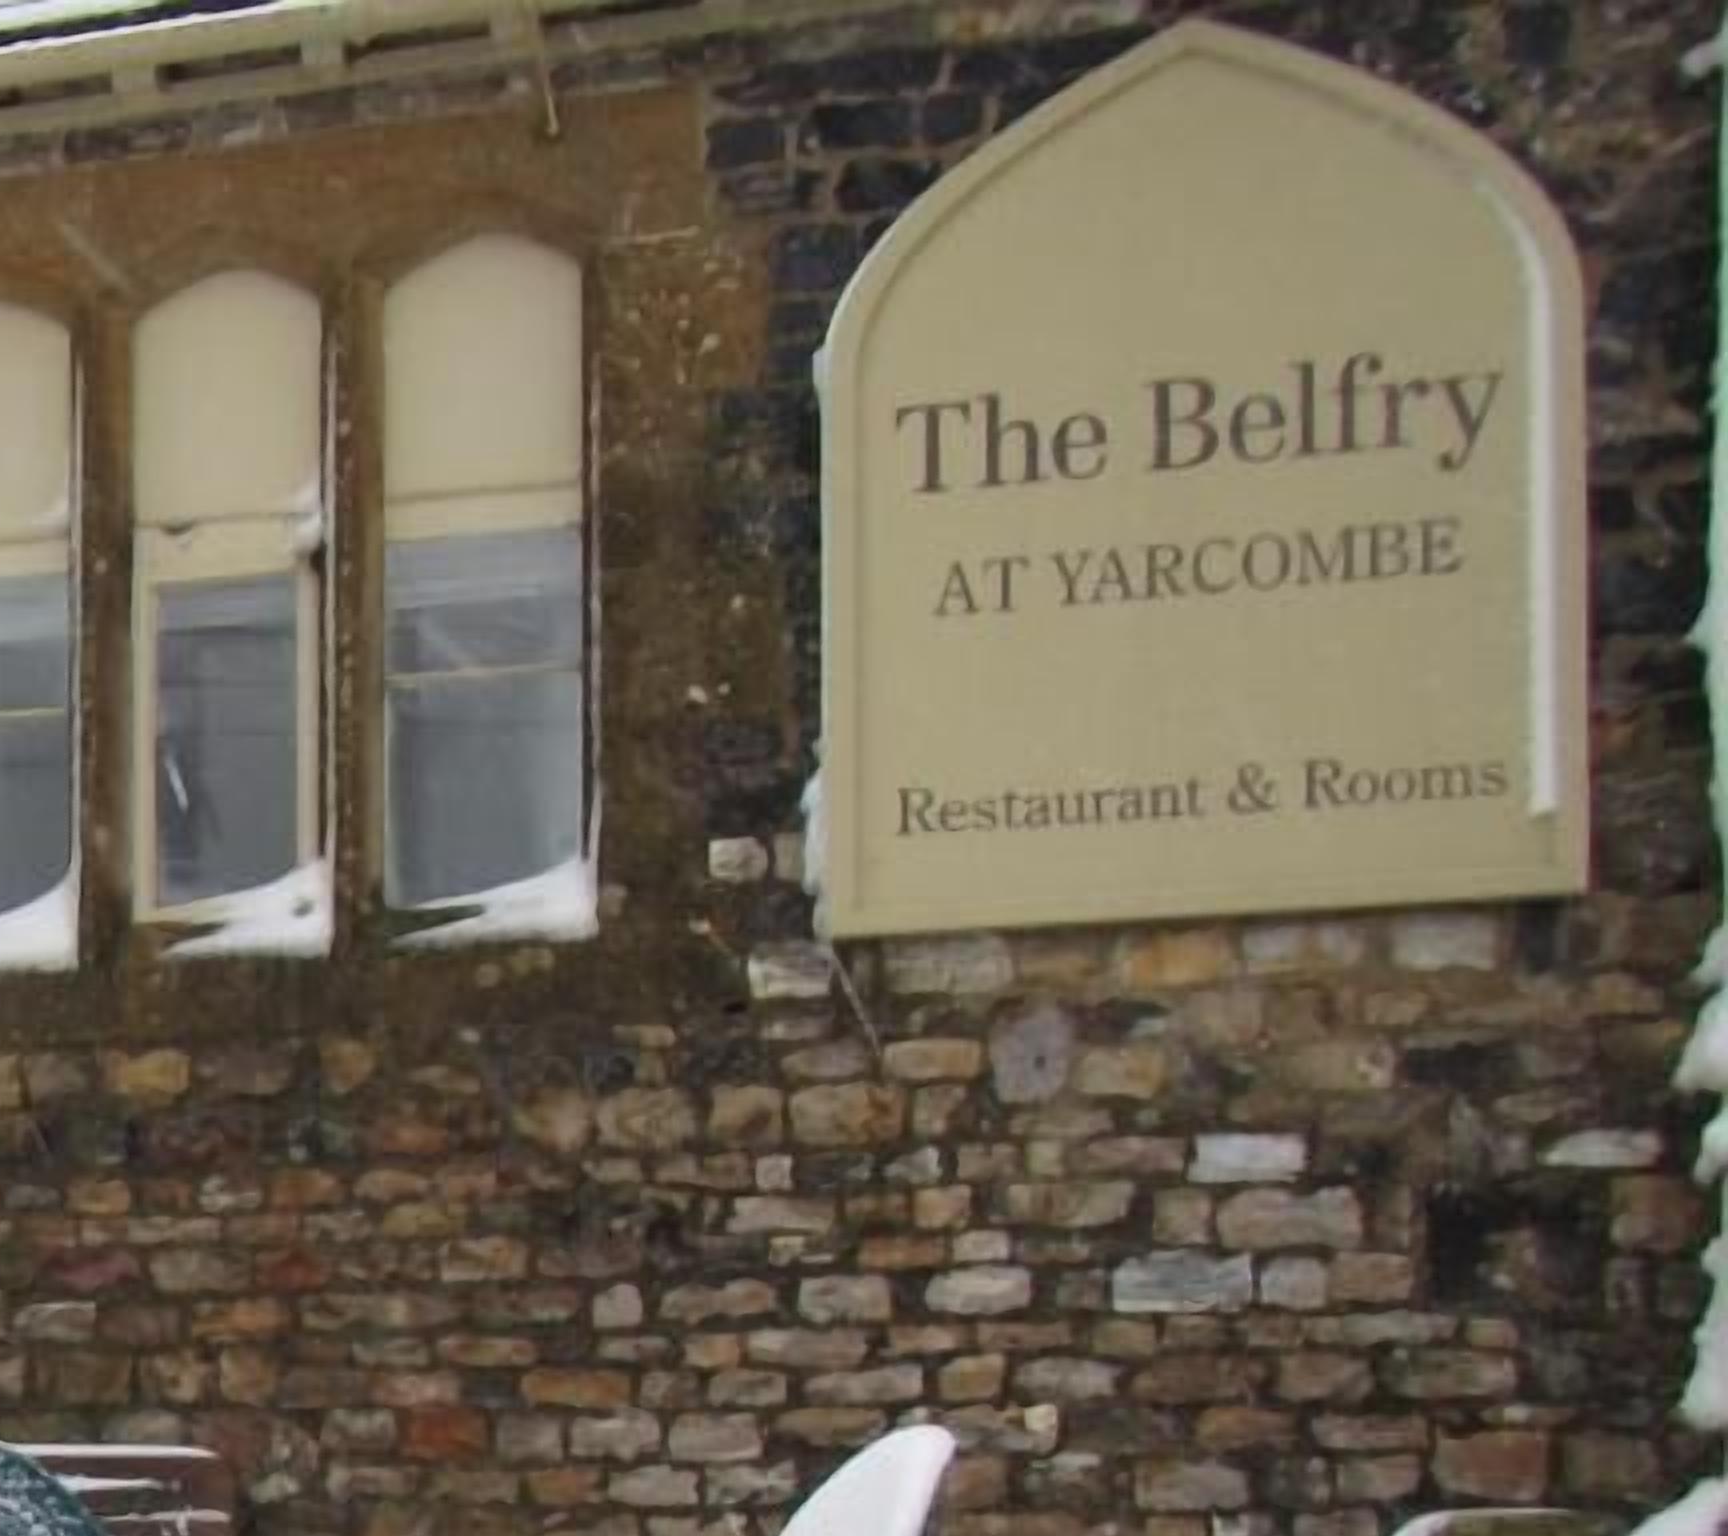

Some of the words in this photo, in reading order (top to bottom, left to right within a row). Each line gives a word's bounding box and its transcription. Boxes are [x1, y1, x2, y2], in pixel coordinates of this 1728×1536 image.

[895, 393, 1109, 495] The
[1143, 351, 1504, 474] Belfry
[932, 555, 1030, 618] AT
[1050, 516, 1465, 608] YARCOMBE
[895, 777, 1206, 838] Restaurant
[1226, 762, 1277, 817] &
[1302, 757, 1511, 810] Rooms
